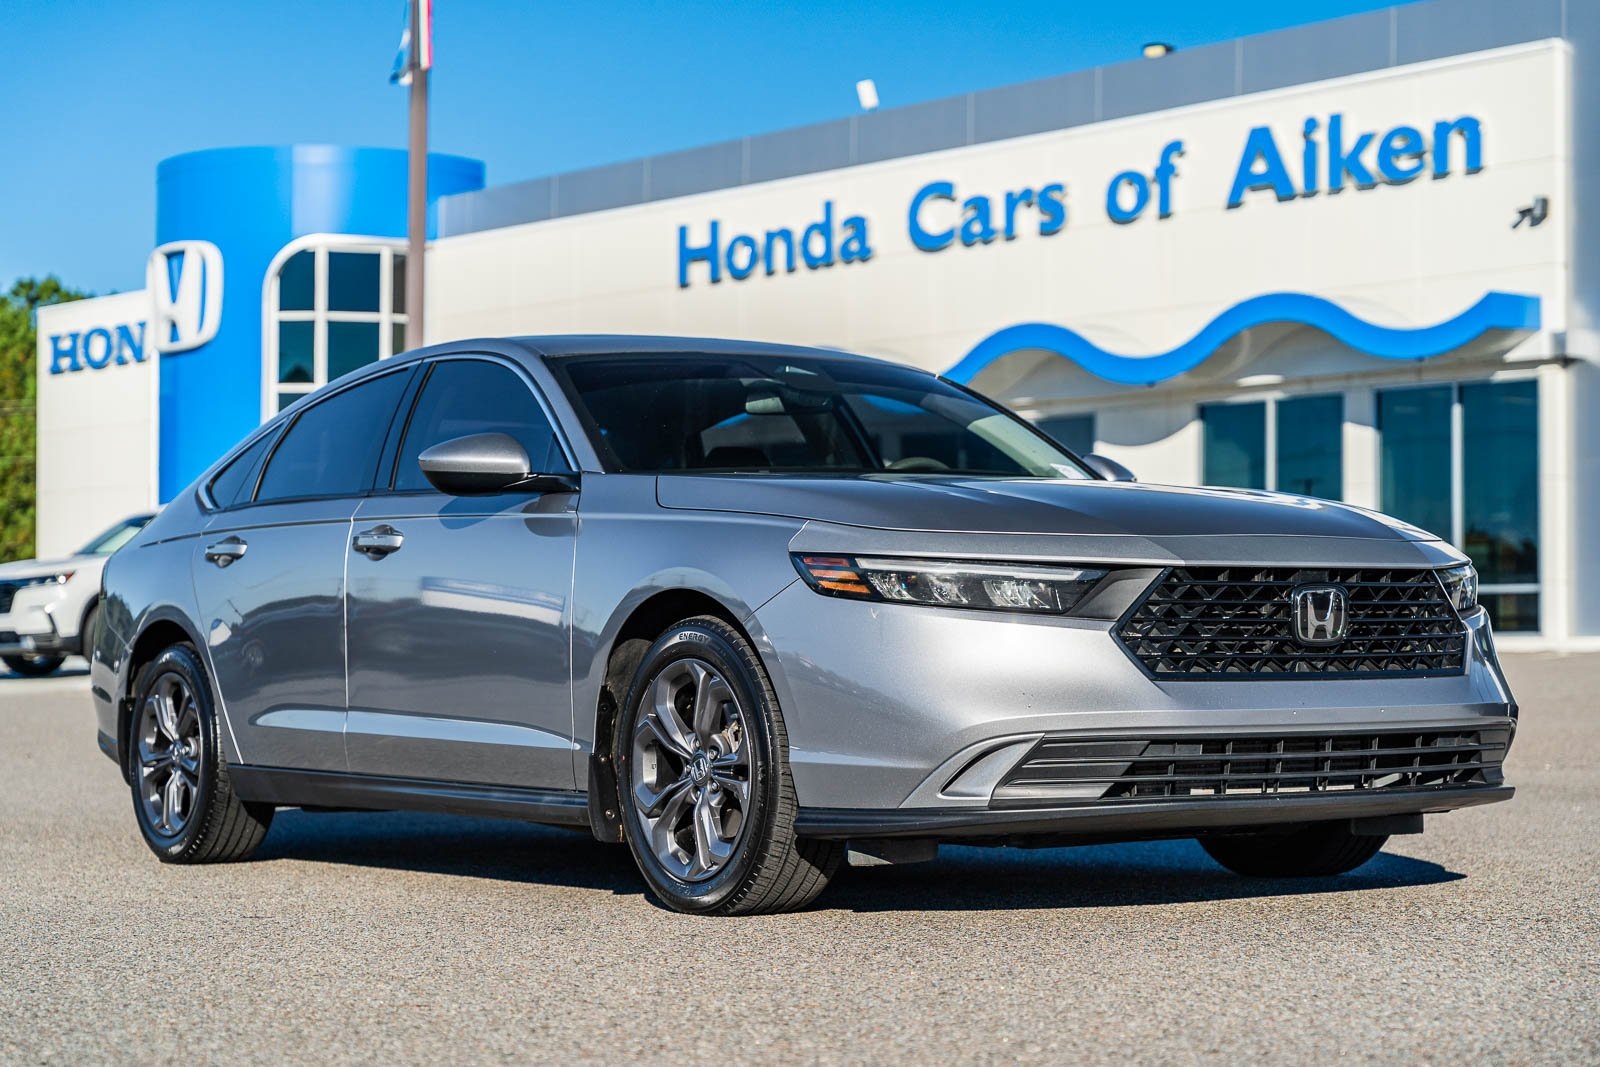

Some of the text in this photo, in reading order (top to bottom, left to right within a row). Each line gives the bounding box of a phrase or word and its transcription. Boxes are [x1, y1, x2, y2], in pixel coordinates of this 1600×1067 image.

[678, 113, 1484, 288] Honda Cars of Aiken
